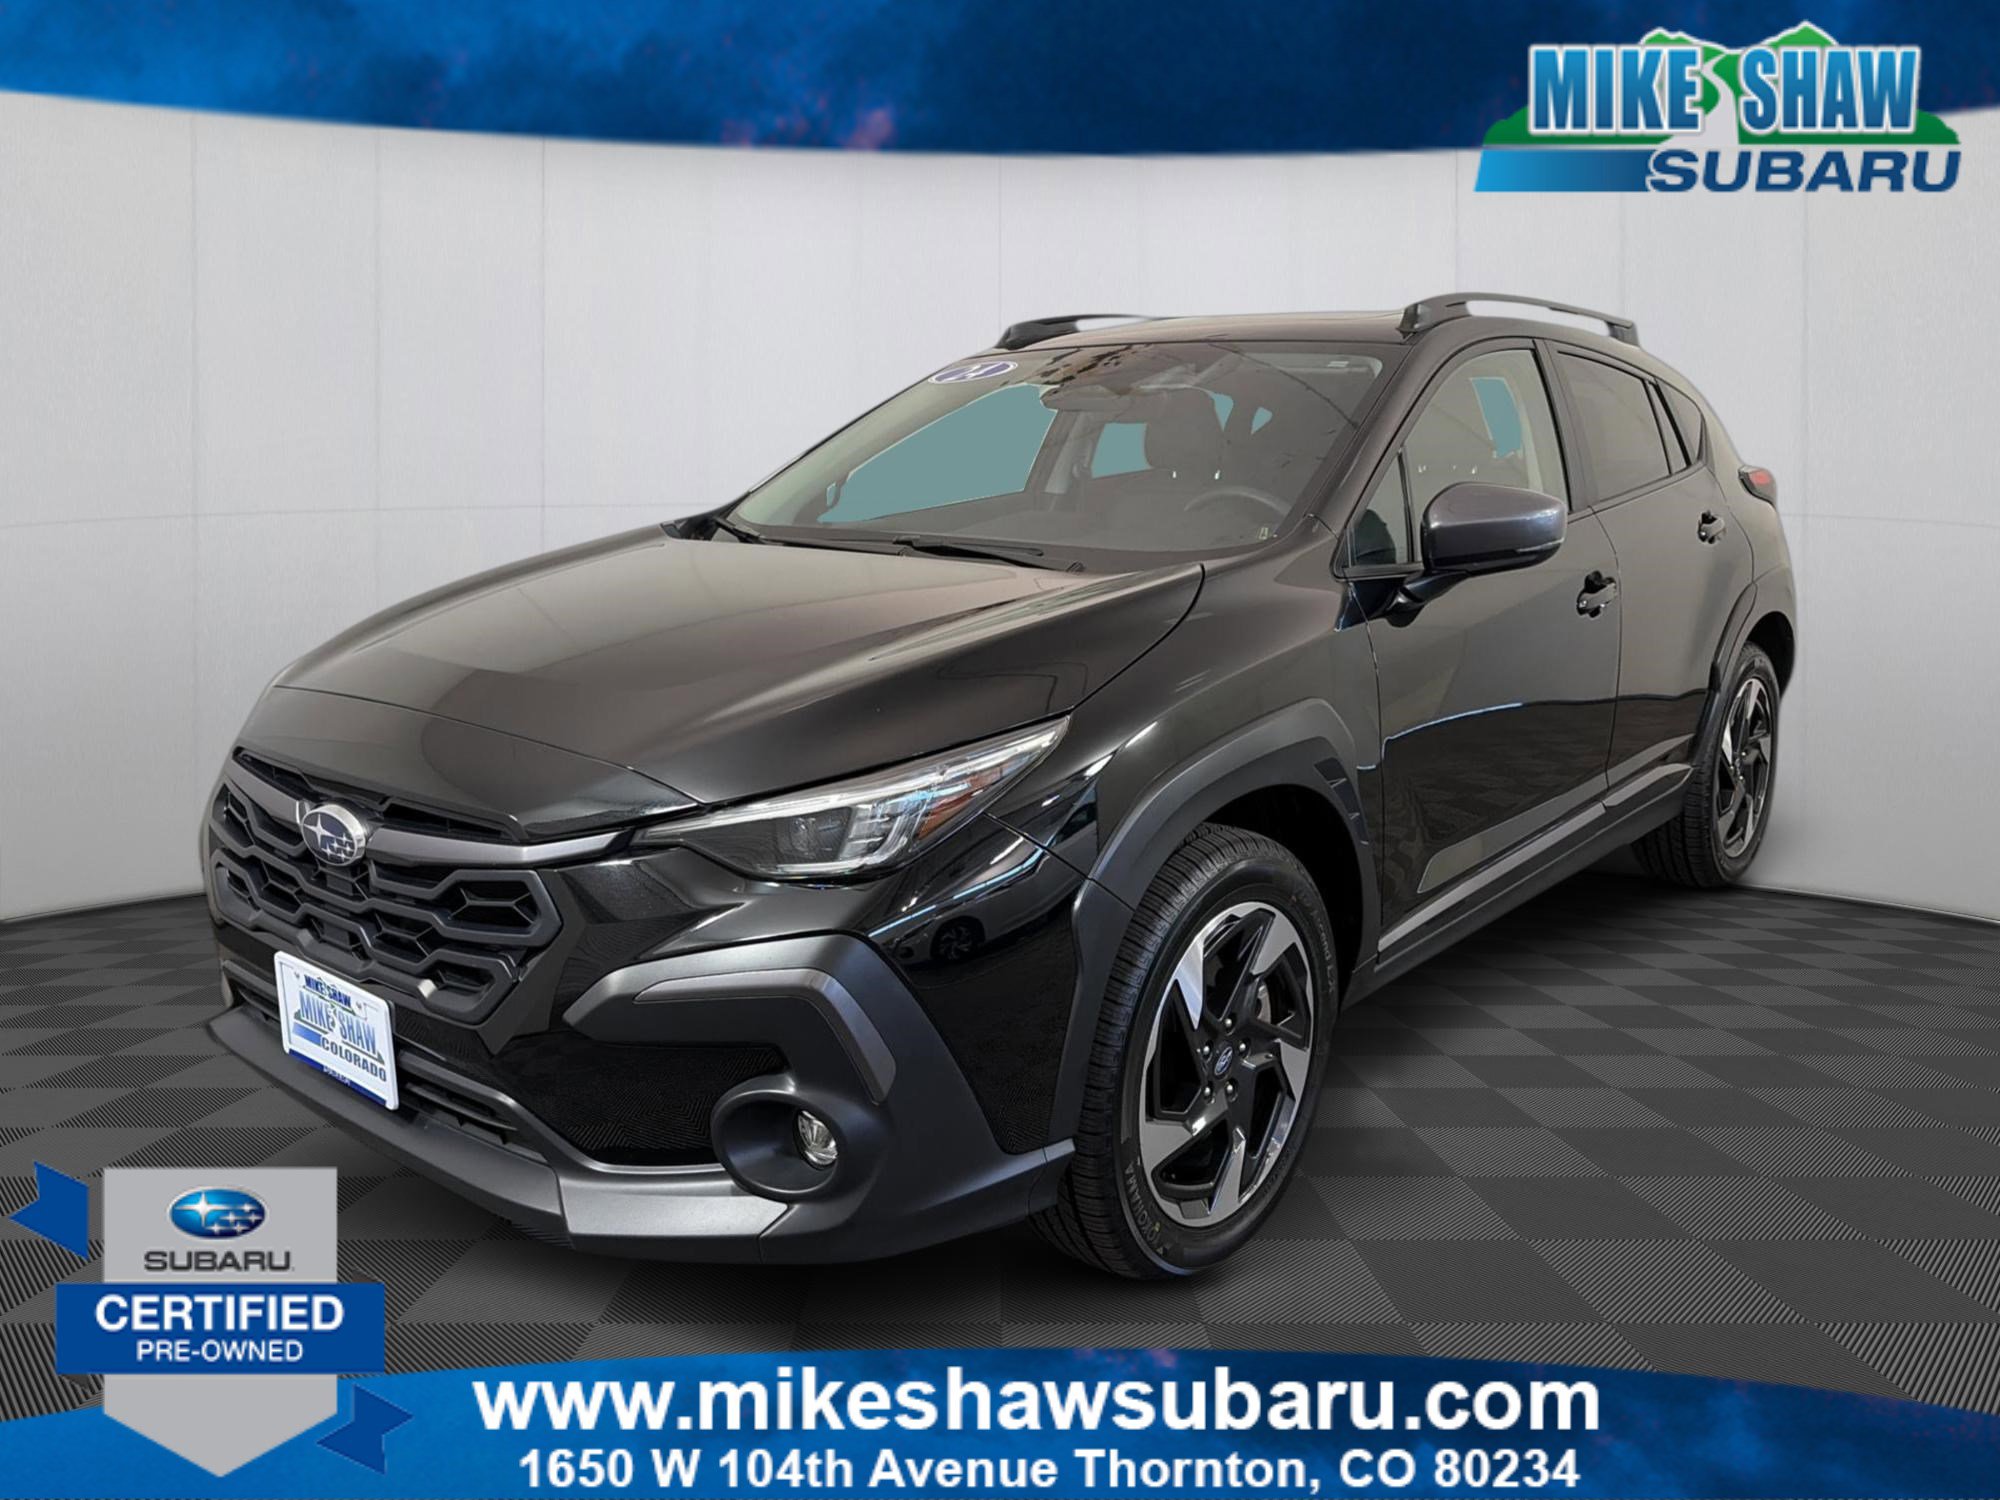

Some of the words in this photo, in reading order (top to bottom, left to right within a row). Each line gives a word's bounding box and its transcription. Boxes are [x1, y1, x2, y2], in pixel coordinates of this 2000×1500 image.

[299, 991, 333, 1032] MIKE
[337, 1011, 377, 1054] SHAW
[321, 1037, 387, 1082] COLORADO
